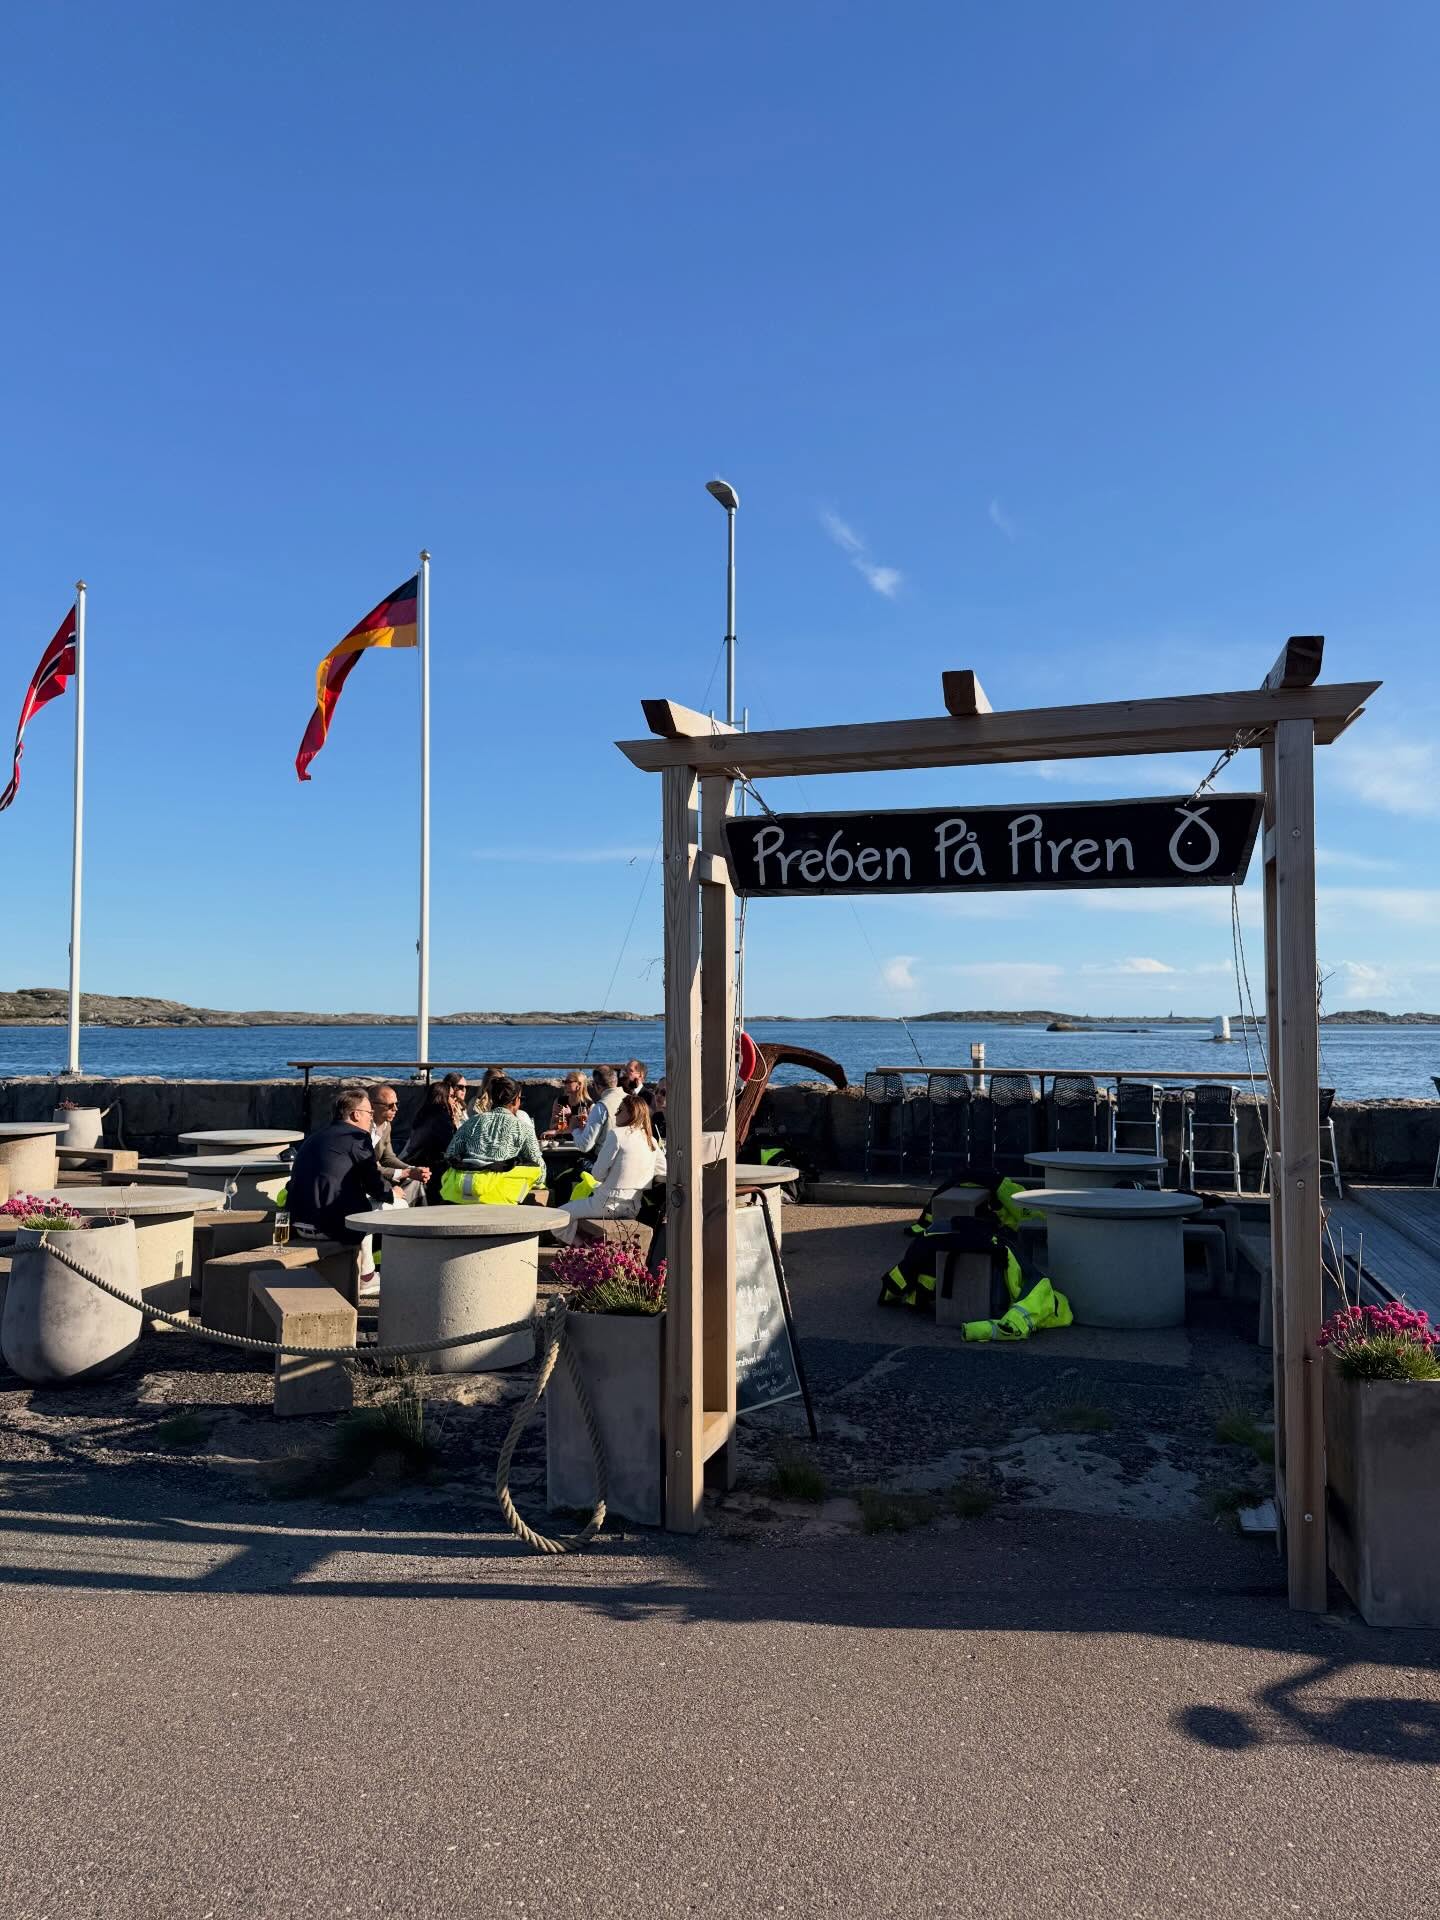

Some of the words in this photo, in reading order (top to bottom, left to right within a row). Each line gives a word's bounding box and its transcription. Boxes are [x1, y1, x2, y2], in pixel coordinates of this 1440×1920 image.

[752, 826, 911, 885] Preben
[934, 818, 986, 877] På
[1007, 814, 1135, 875] Piren
